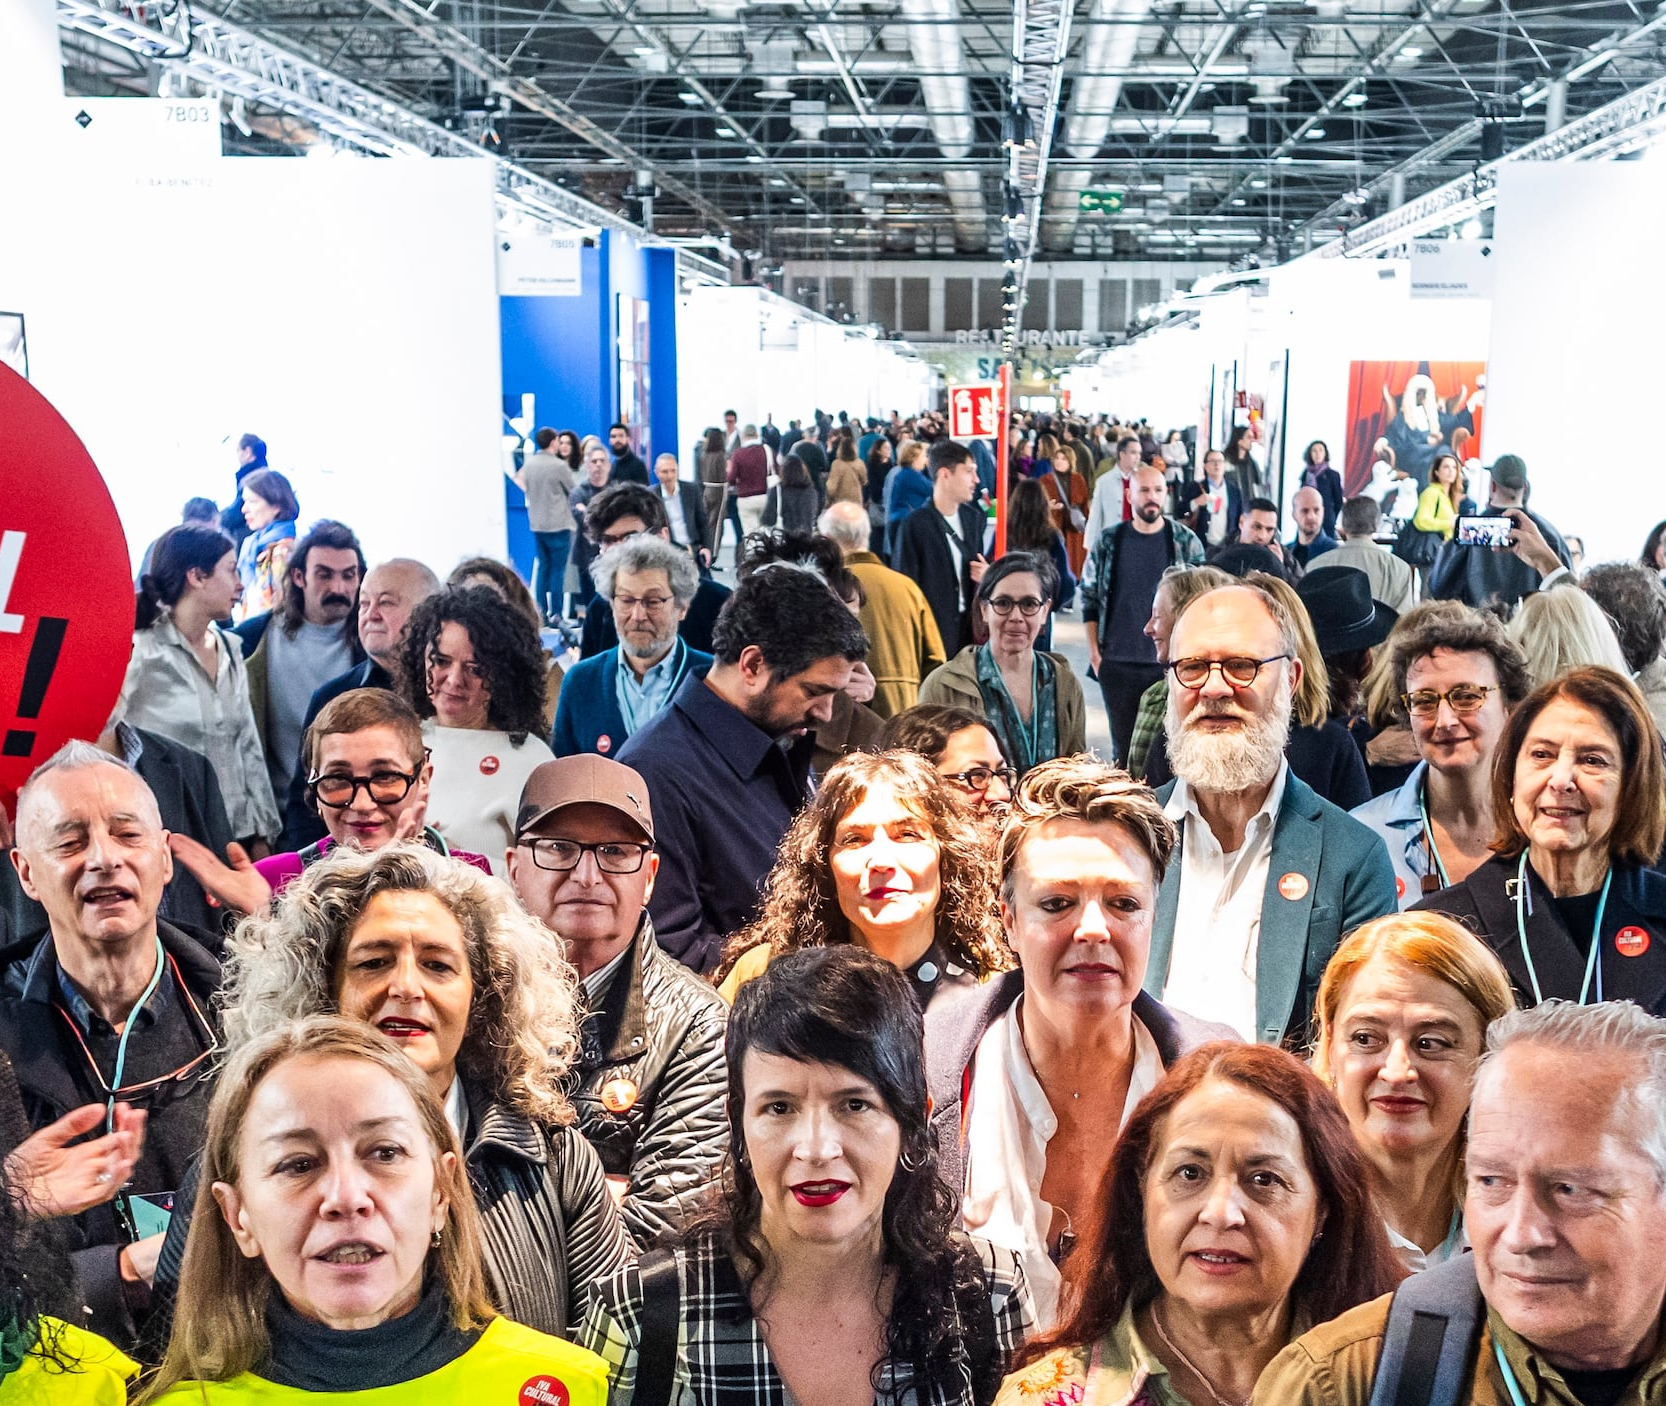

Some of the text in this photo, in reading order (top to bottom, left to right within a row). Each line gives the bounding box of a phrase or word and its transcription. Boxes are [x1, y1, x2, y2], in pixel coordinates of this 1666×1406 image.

[164, 105, 210, 122] 7B03
[536, 1379, 551, 1392] IVA
[523, 1386, 562, 1406] CULTURAL
